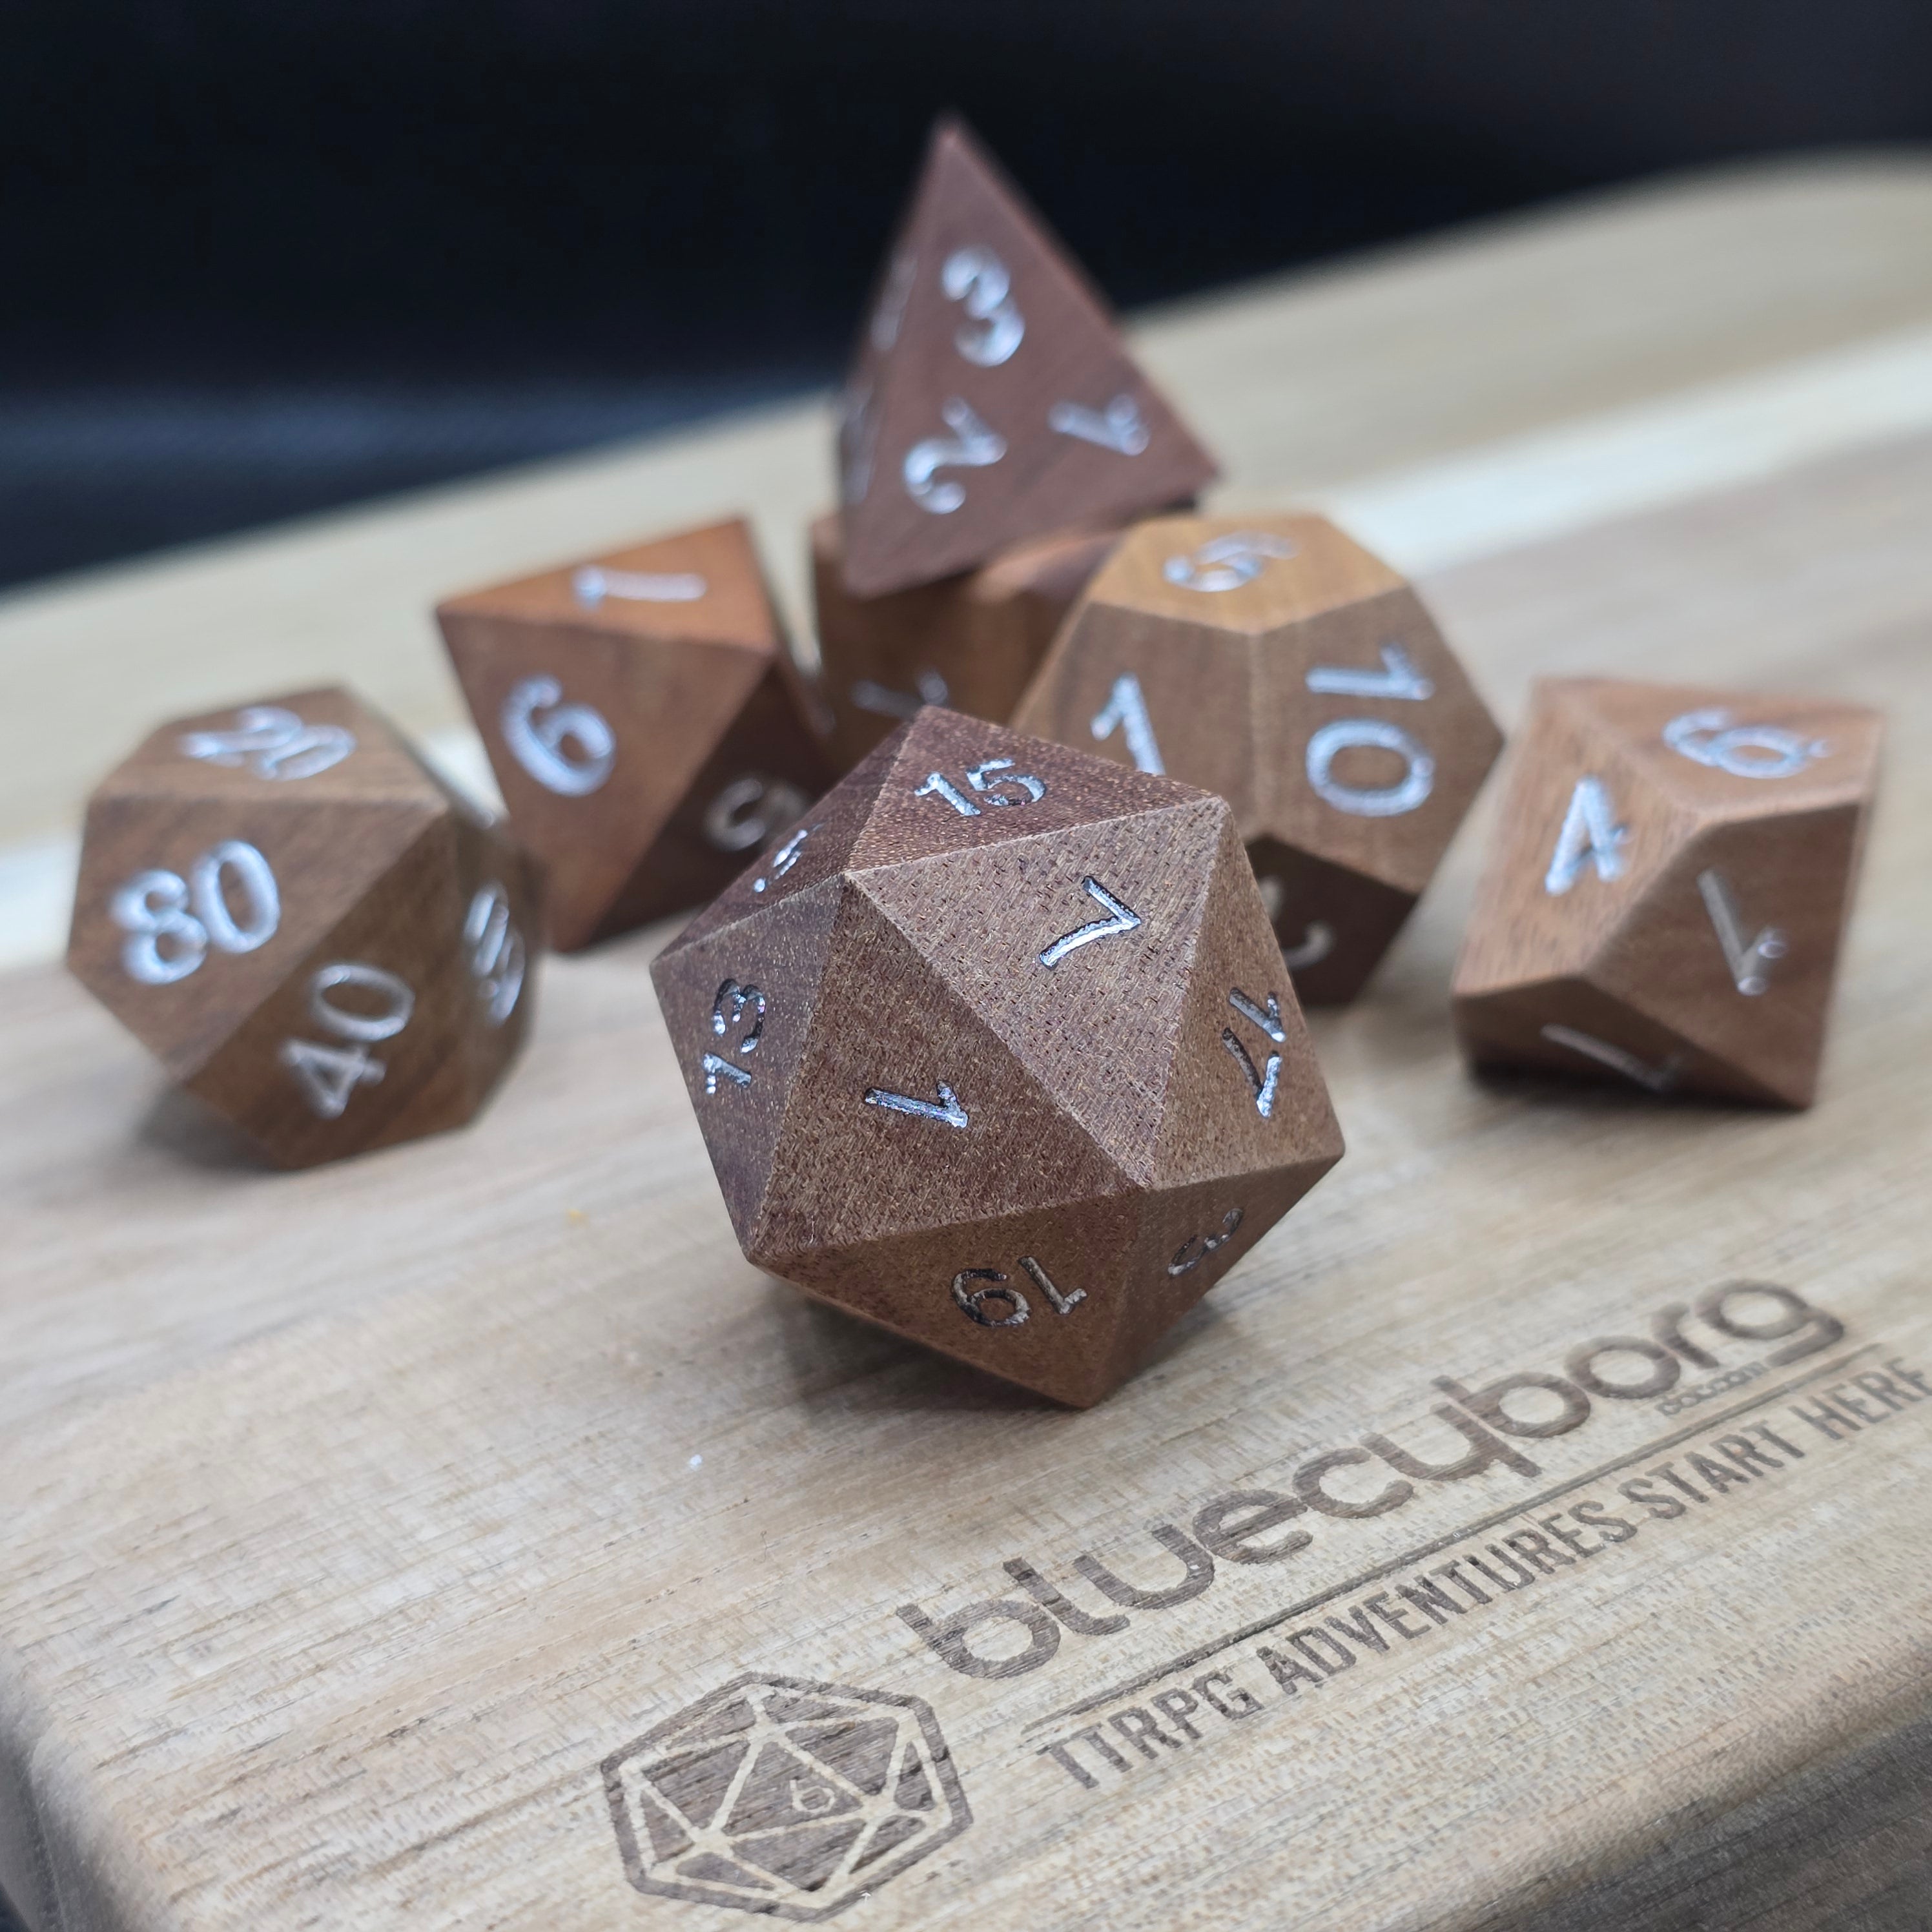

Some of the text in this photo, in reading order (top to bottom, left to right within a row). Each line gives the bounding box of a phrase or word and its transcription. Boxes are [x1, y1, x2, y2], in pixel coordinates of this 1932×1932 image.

[941, 244, 1025, 368] 3
[904, 395, 1007, 515] 2
[573, 565, 707, 611] 1
[500, 675, 617, 798] 6
[914, 757, 1047, 817] 15
[1303, 641, 1435, 818] 10
[1545, 774, 1629, 896] 4
[111, 839, 281, 985] 80
[1038, 874, 1142, 968] 7
[278, 961, 415, 1118] 40
[703, 978, 766, 1094] 13
[1222, 987, 1287, 1118] 17
[865, 1080, 969, 1128] 1
[951, 1256, 1087, 1328] 19
[895, 1277, 1845, 1680] bluecyborg
[1035, 1670, 1264, 1790] TTRPG
[1255, 1499, 1638, 1696] ADVENTURES
[1616, 1419, 1806, 1520] START
